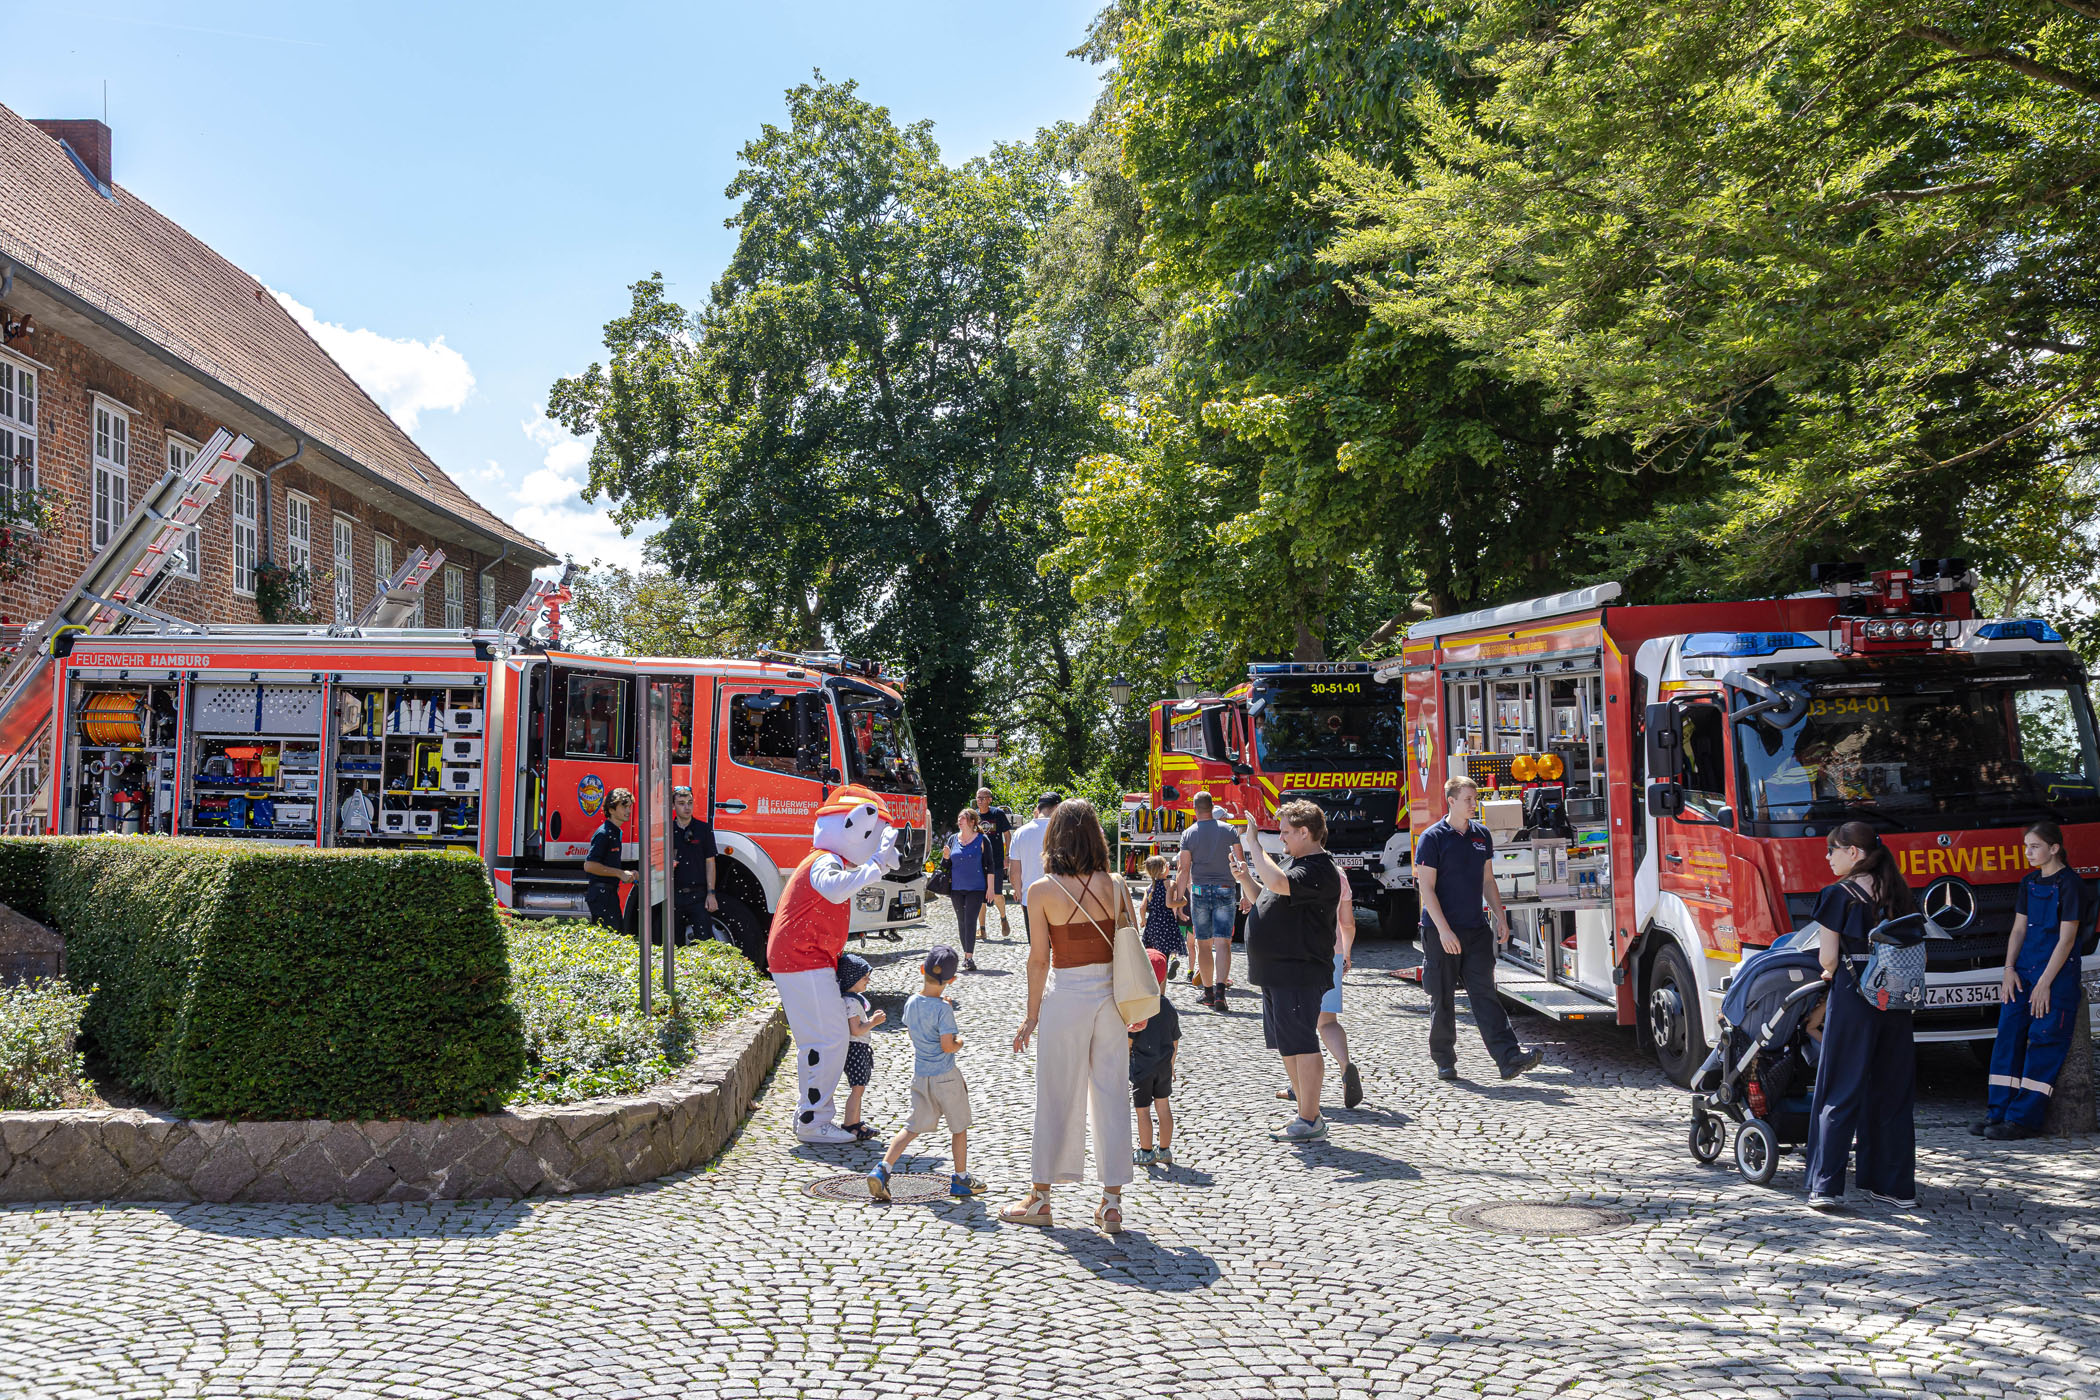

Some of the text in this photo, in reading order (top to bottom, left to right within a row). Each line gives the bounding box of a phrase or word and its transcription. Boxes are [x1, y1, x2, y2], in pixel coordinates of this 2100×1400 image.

[76, 654, 210, 666] FEUERWEHR HAMBURG
[1311, 683, 1361, 694] 30-51-01
[1282, 771, 1398, 788] FEUERWEHR
[770, 800, 818, 809] FEUERWEHR
[770, 807, 809, 815] HAMBURG
[1346, 858, 1363, 866] 5101
[1899, 844, 2042, 875] UERWEH
[1946, 988, 1963, 1002] KS
[1966, 986, 2000, 1002] 3541
